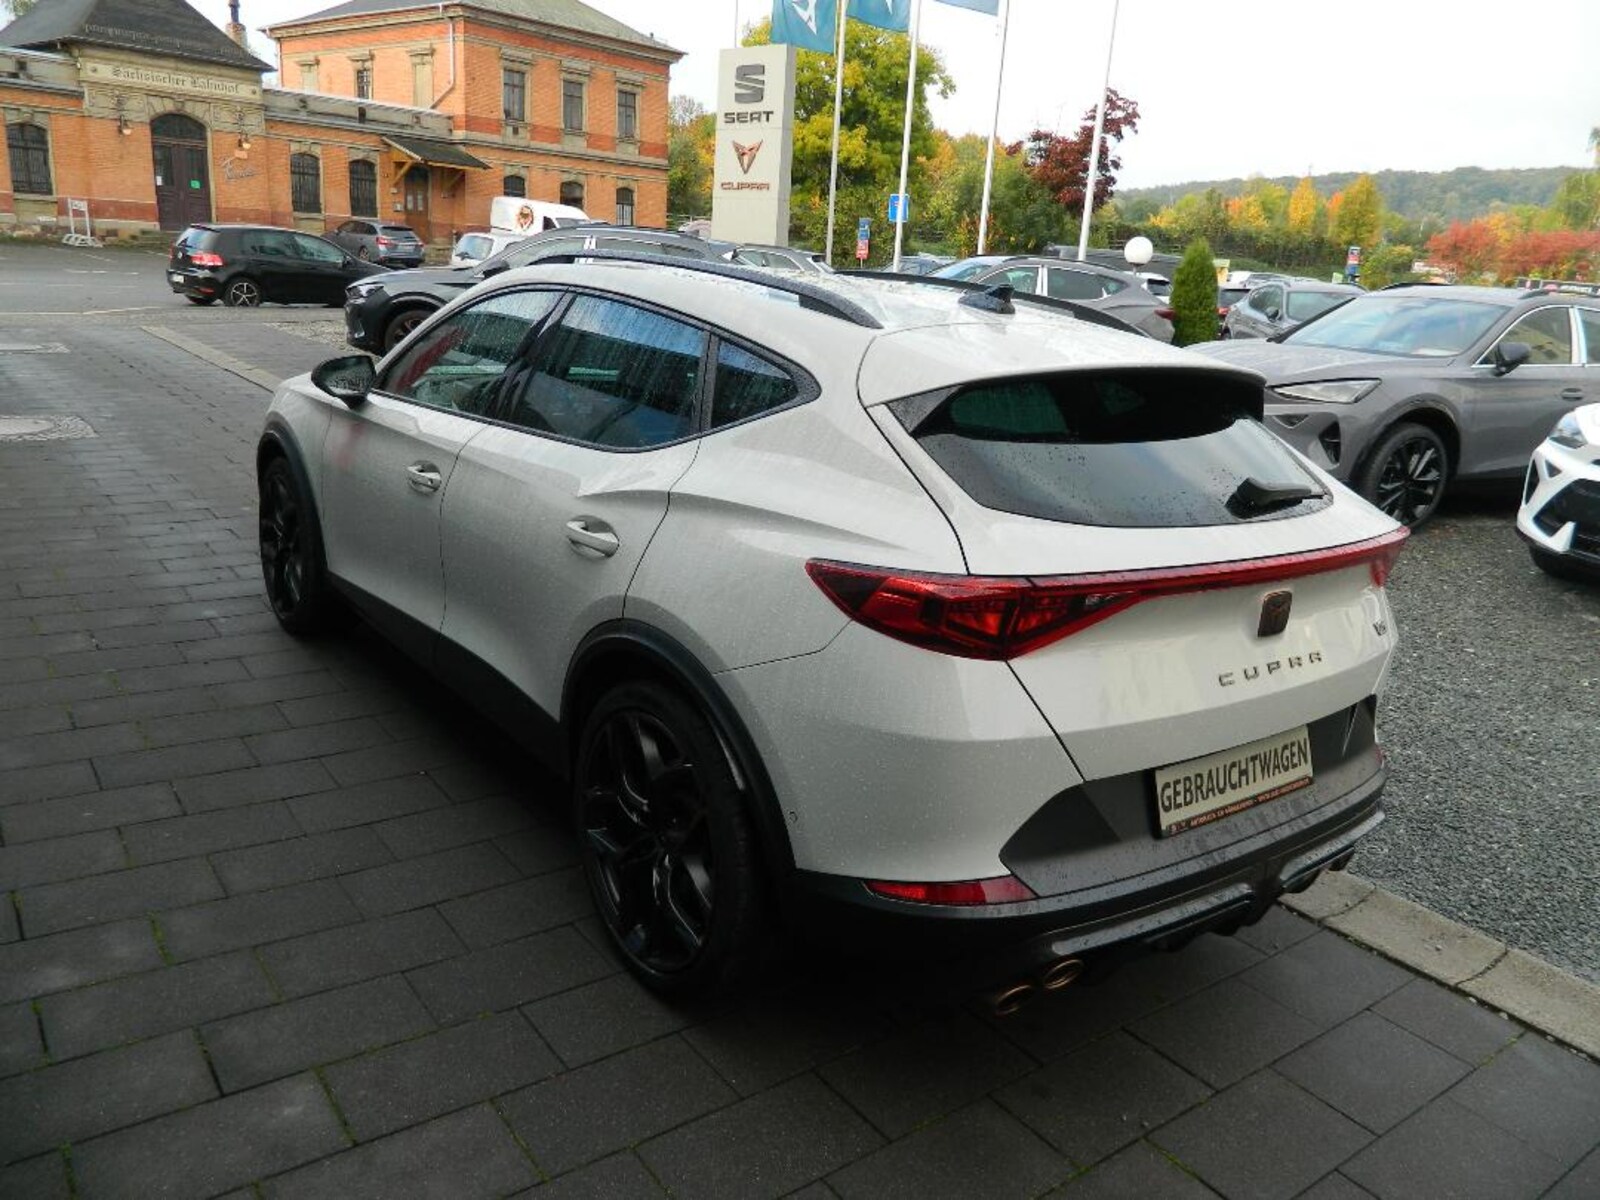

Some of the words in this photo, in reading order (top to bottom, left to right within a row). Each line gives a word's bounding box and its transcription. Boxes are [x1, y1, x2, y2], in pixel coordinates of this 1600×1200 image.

[724, 110, 774, 123] SEAT
[720, 182, 770, 191] CUPRA
[1218, 651, 1323, 687] CUPRA
[1159, 737, 1309, 813] GEBRAUCHTWAGEN
